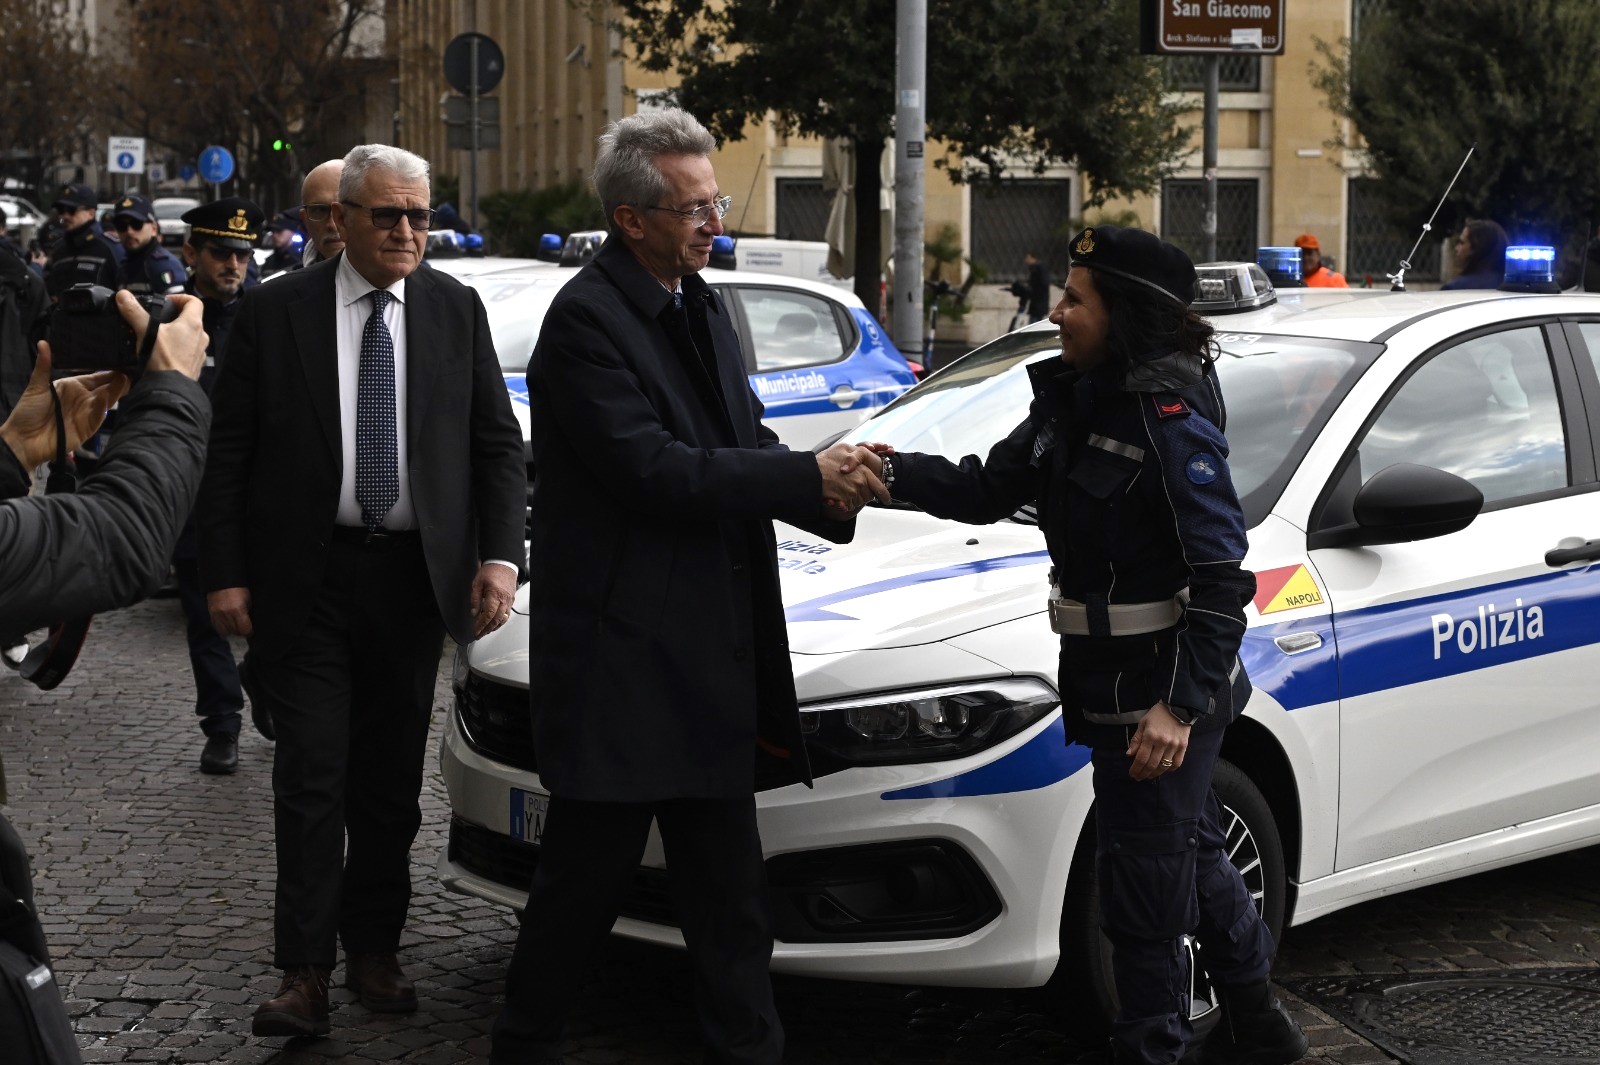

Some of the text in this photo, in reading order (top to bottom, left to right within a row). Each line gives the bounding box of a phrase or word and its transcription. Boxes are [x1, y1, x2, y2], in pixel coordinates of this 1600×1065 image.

[1172, 0, 1271, 18] San Giacomo
[1219, 34, 1232, 45] Luig
[1263, 35, 1276, 44] 825
[754, 371, 826, 395] Municipale
[777, 540, 832, 554] lizia
[1286, 592, 1321, 606] NAPOLI
[1431, 598, 1545, 660] Polizia
[529, 796, 549, 813] POLI
